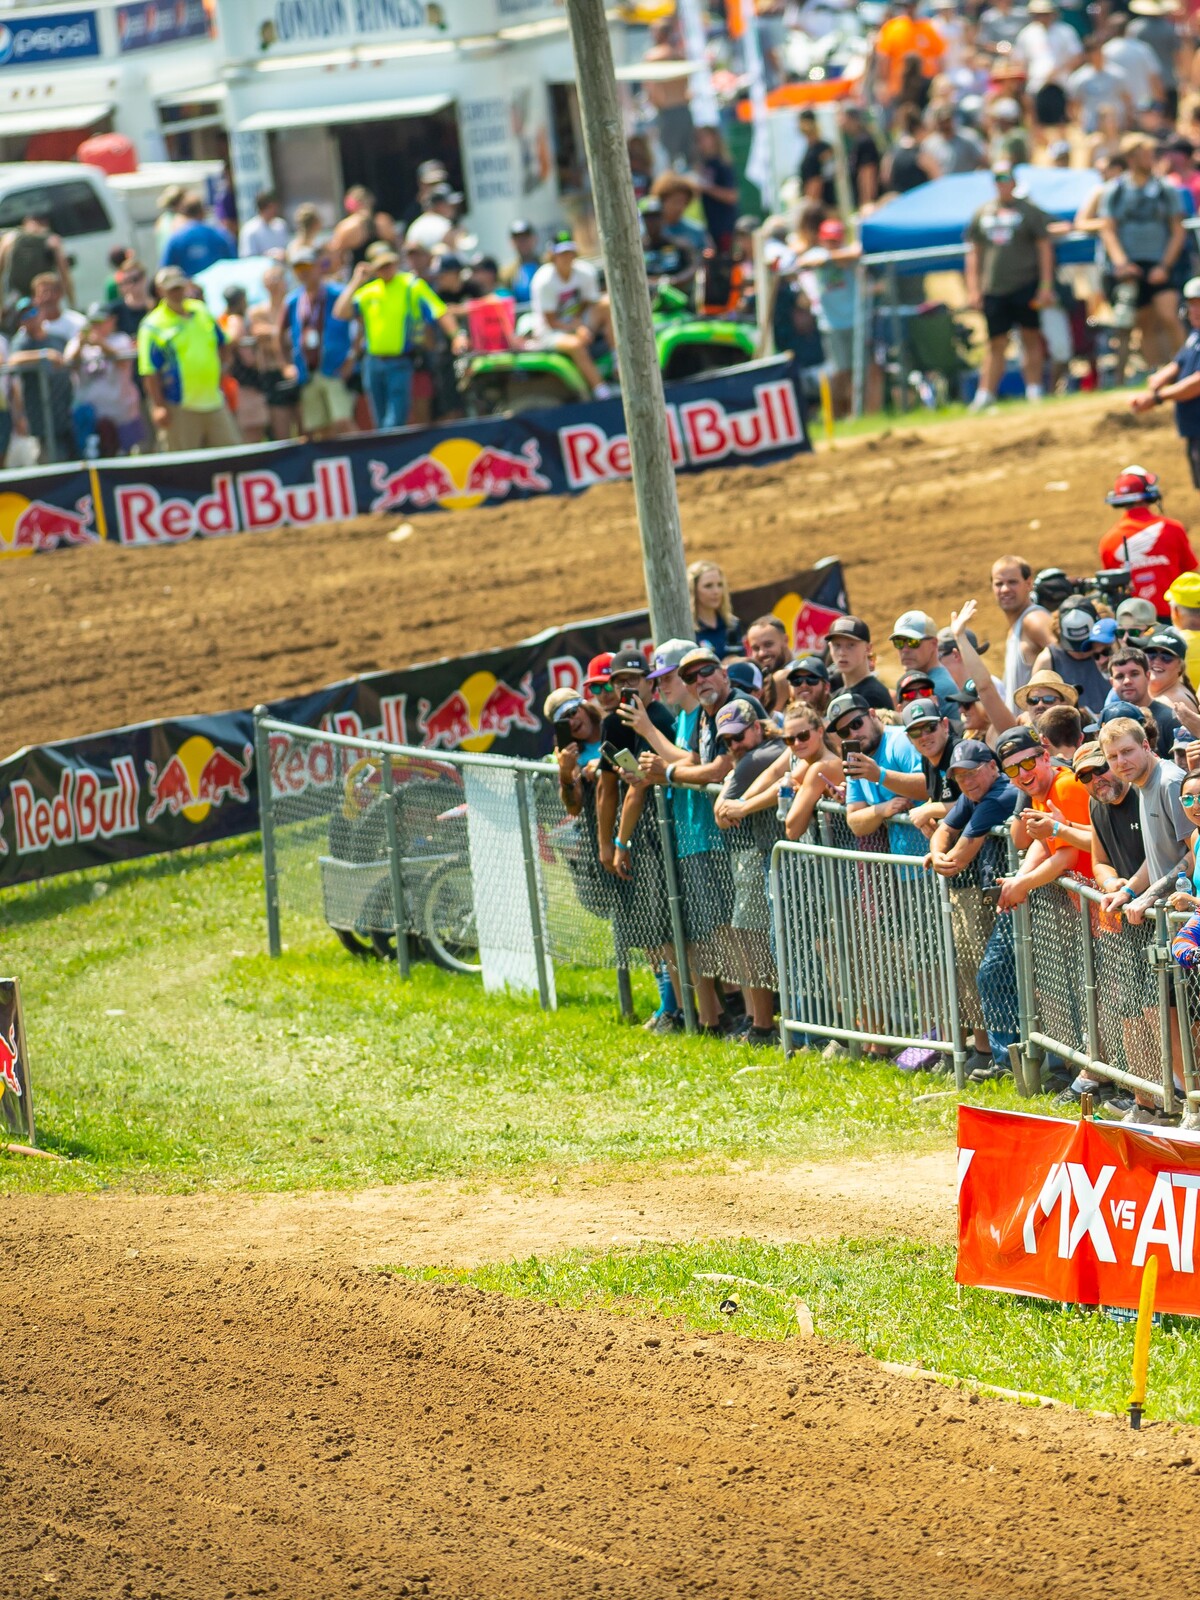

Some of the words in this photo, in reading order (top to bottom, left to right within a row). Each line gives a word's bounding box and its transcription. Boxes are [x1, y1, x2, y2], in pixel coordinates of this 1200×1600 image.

[14, 19, 91, 57] pepsi
[562, 405, 682, 486] Re
[683, 383, 801, 461] Bull
[117, 476, 237, 544] Red
[240, 459, 356, 530] Bull
[12, 771, 73, 851] Red
[75, 756, 139, 840] Bull
[1023, 1162, 1118, 1263] MX
[1110, 1199, 1137, 1230] VS
